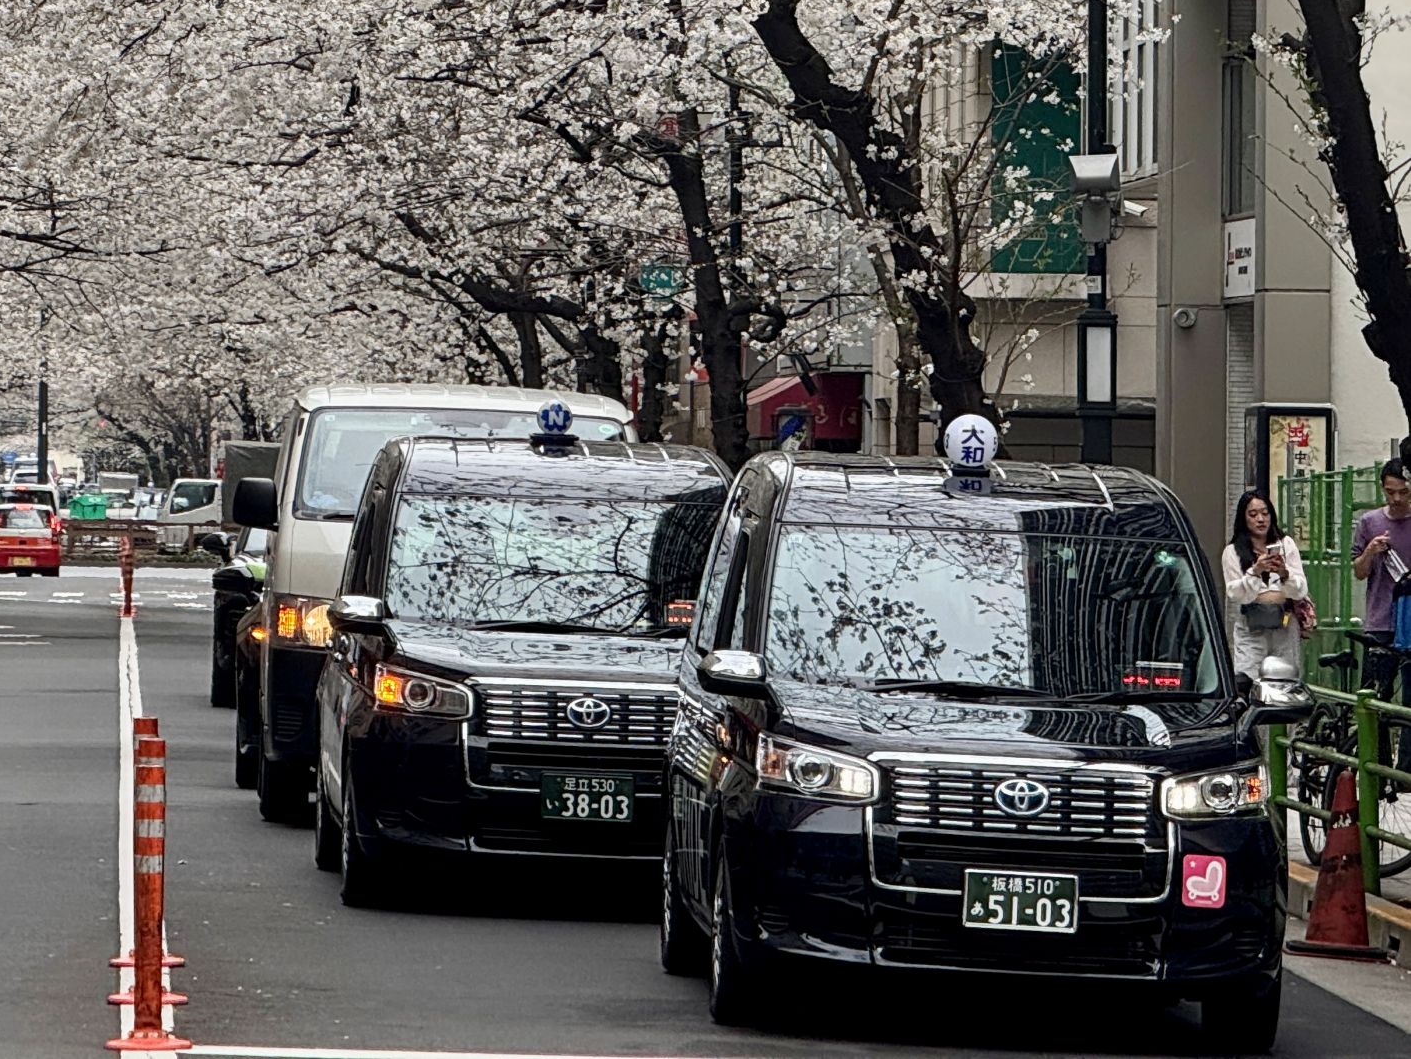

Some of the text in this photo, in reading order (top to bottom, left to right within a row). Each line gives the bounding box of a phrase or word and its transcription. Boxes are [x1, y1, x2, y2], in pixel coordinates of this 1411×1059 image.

[549, 411, 564, 426] N
[961, 425, 985, 463] 大和
[561, 793, 629, 819] 38-03
[988, 894, 1071, 927] 51-03
